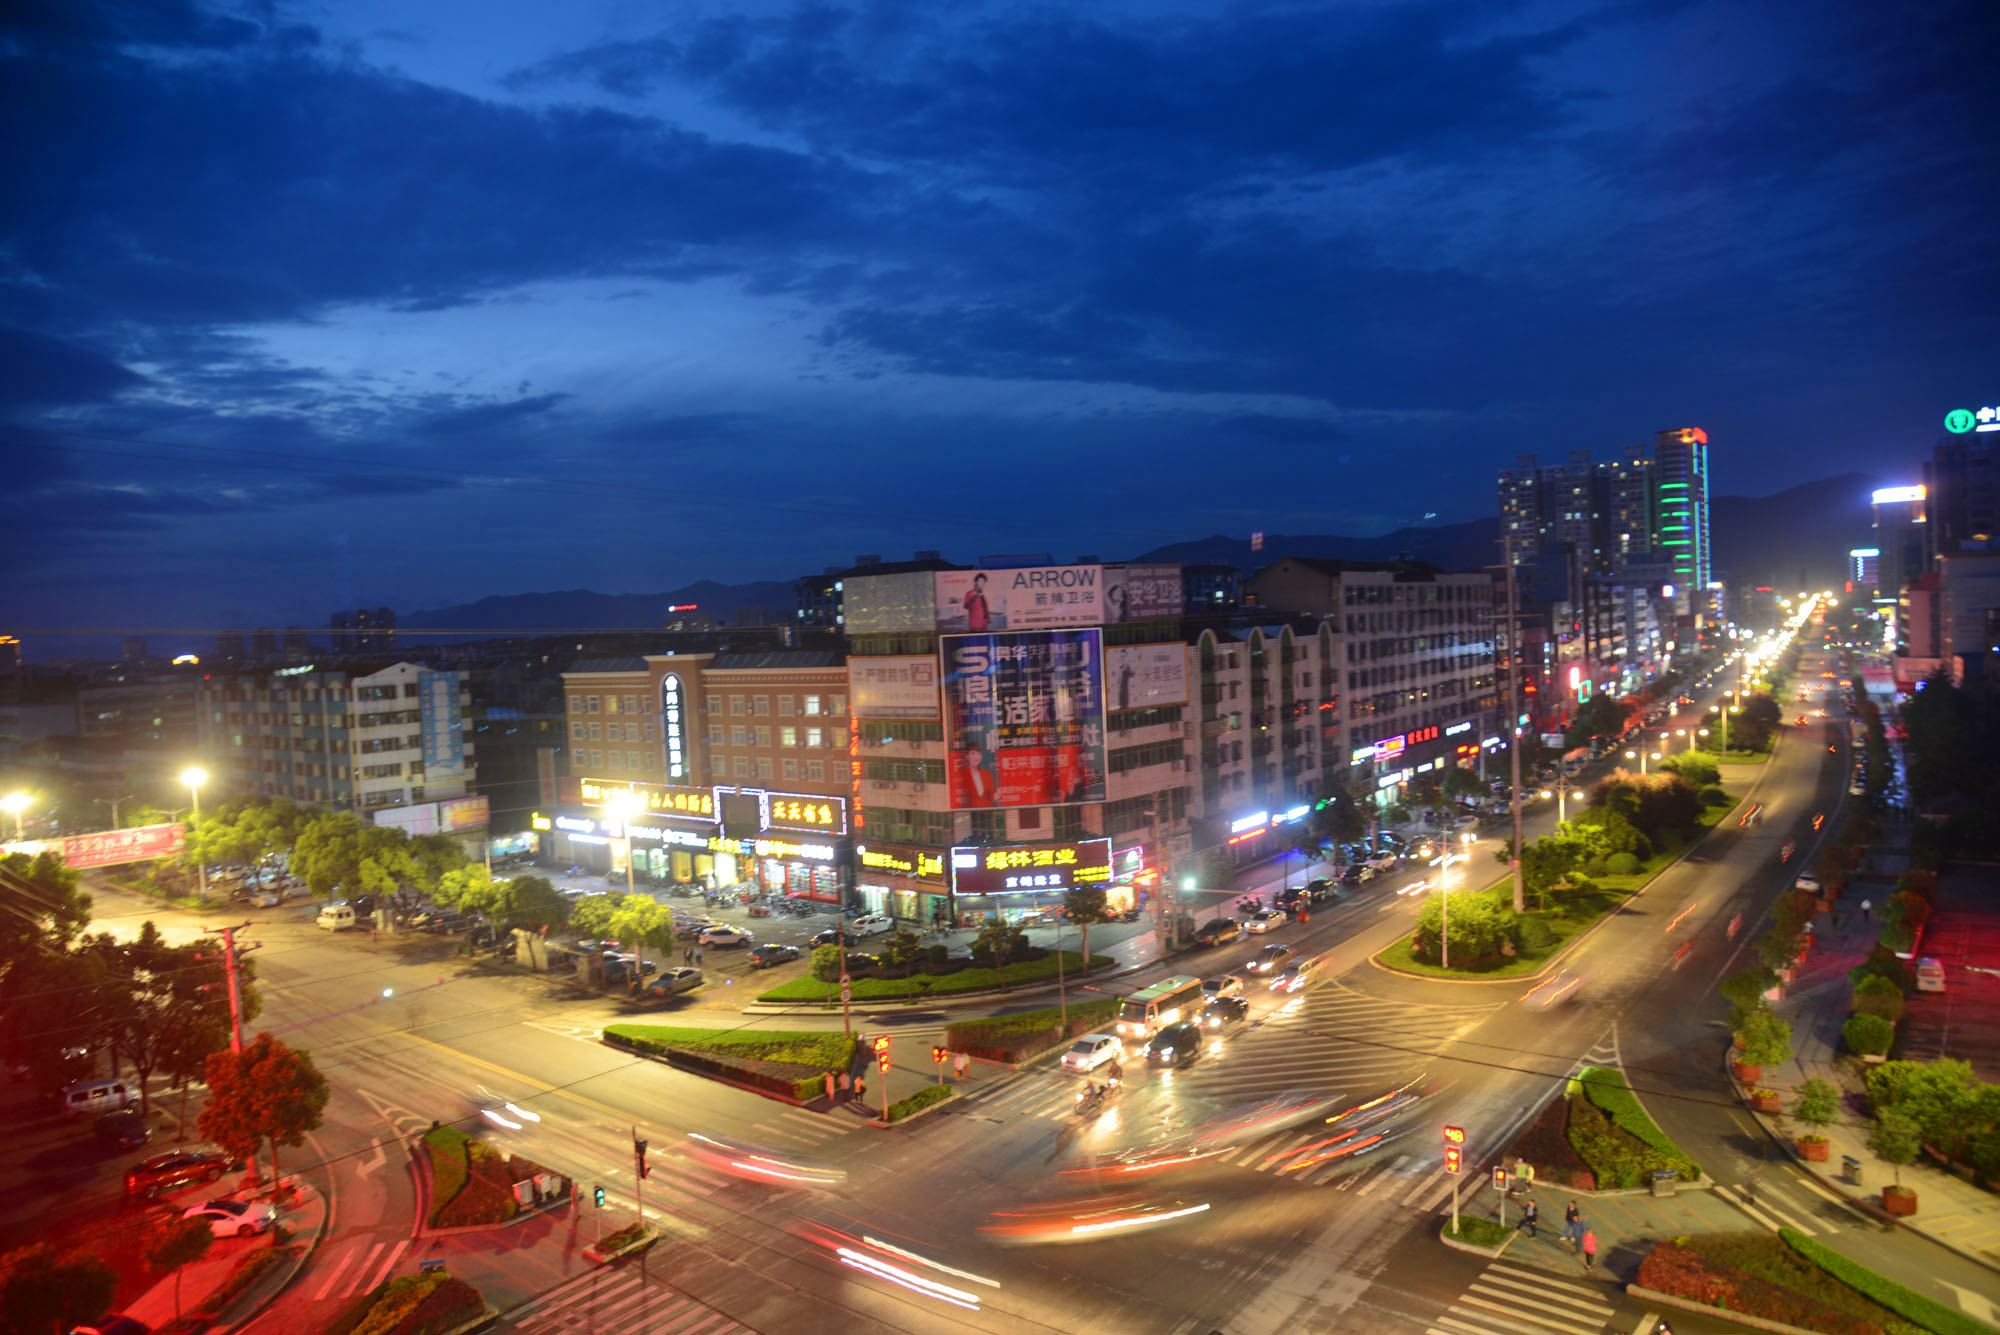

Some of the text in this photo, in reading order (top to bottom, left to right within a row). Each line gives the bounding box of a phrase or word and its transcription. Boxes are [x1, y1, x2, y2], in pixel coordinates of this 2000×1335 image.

[1975, 406, 2000, 424] 中
[1012, 568, 1096, 590] ARROW
[1128, 578, 1181, 605] 安华卫浴
[772, 800, 833, 825] 天天有鱼
